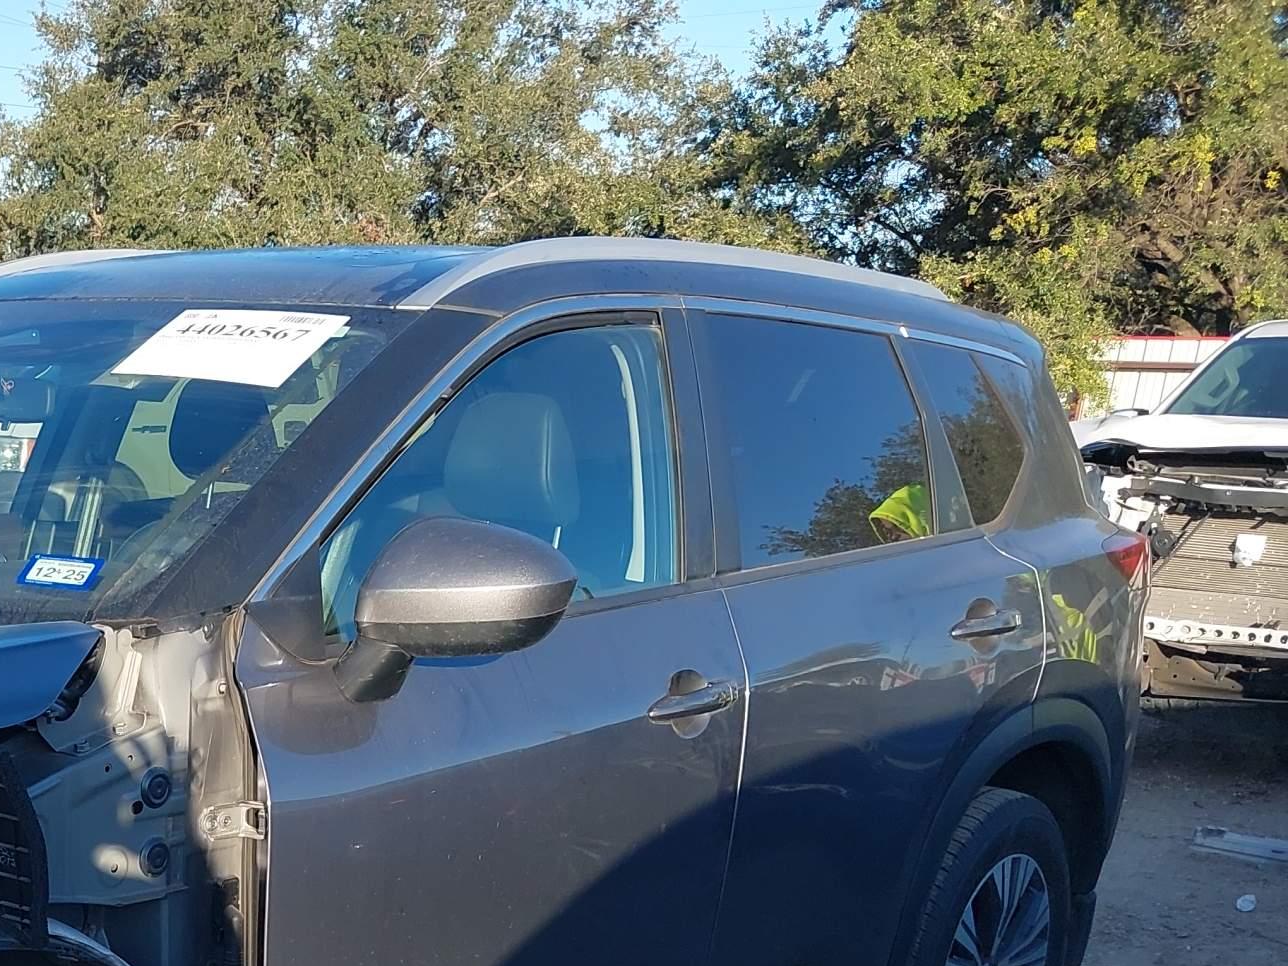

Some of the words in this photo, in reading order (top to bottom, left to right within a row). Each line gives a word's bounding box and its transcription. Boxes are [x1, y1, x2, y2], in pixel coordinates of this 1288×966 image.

[176, 323, 312, 342] 44026567
[35, 566, 57, 578] 12
[62, 569, 88, 581] 25
